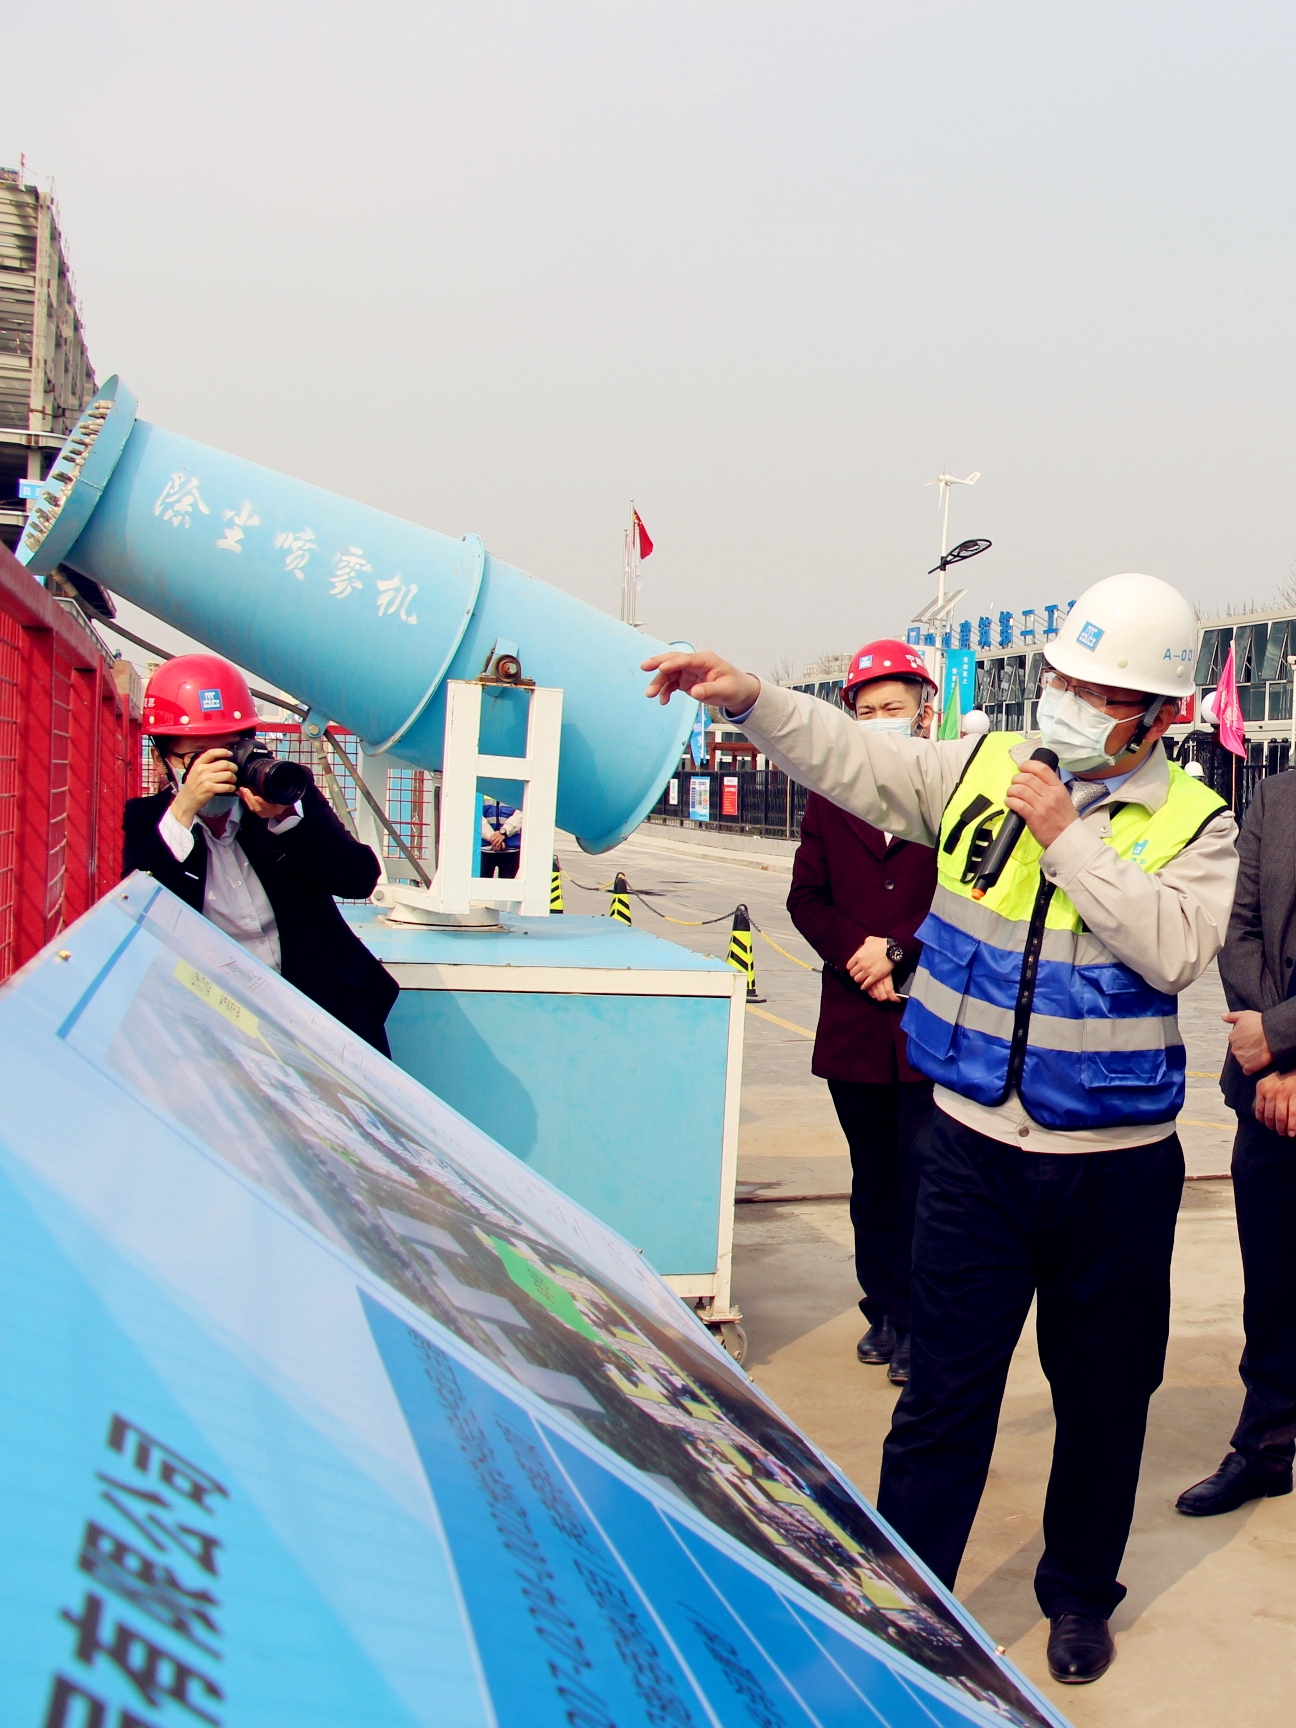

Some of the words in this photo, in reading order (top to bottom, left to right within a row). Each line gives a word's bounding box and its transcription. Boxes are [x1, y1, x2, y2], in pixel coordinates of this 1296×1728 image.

[154, 474, 418, 626] 除尘喷雾机
